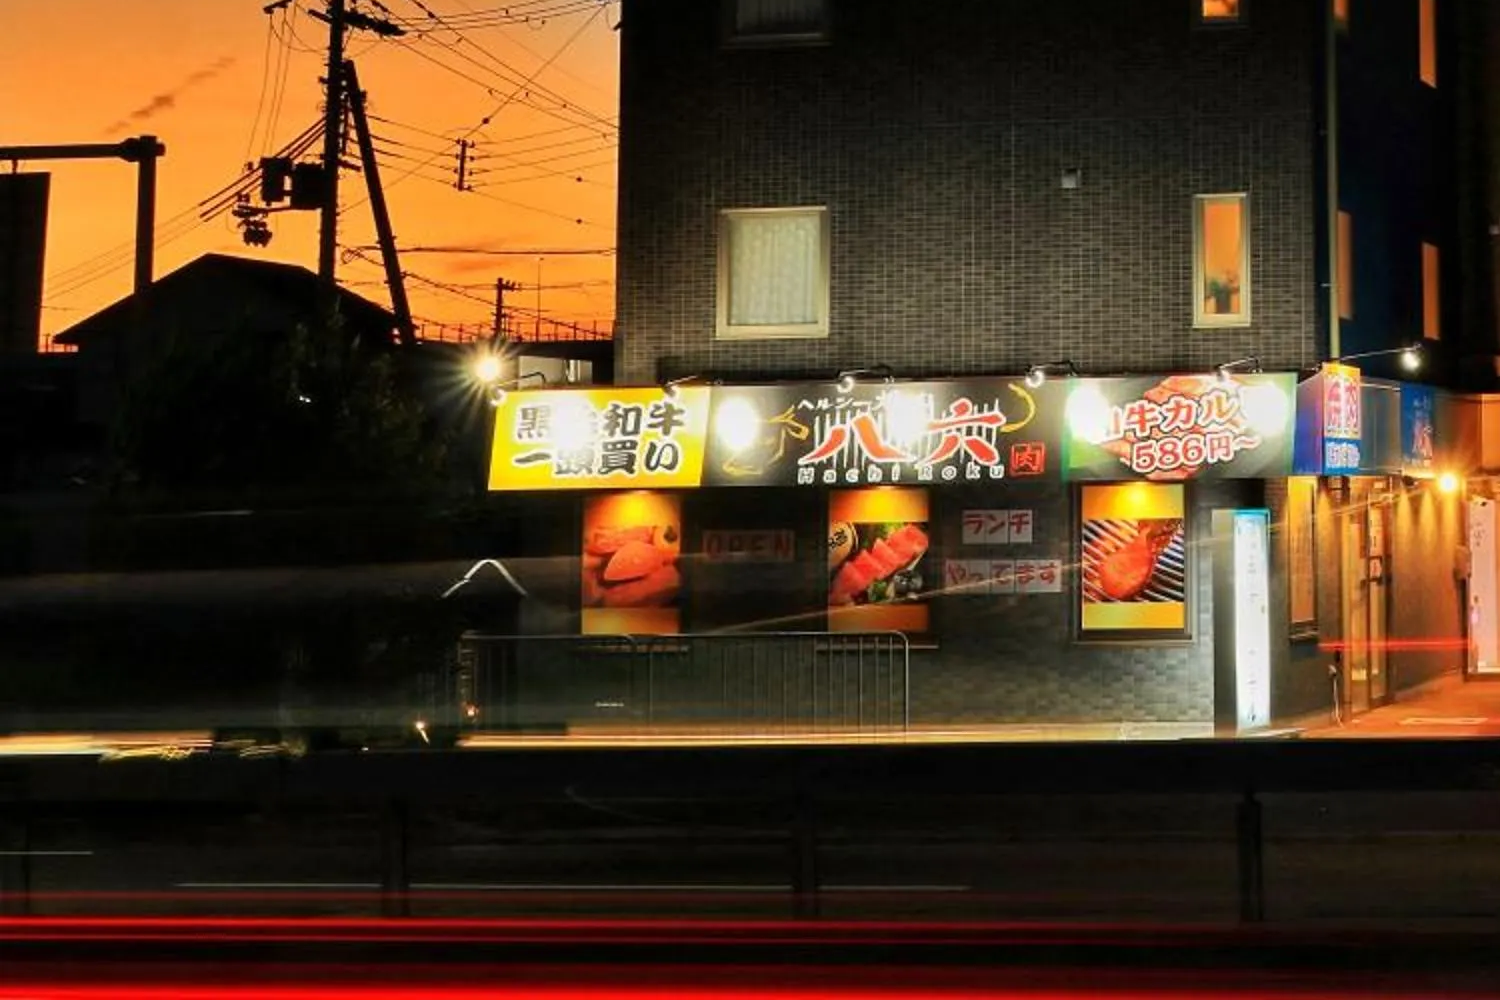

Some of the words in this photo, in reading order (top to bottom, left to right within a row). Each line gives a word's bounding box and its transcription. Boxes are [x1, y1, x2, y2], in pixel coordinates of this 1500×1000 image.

[517, 402, 685, 439] 黒和牛
[797, 397, 1006, 467] 八六
[798, 464, 900, 484] Hachi
[917, 463, 1005, 481] Roku
[963, 513, 1030, 534] ランチ
[706, 533, 790, 557] OPEN
[947, 563, 1058, 585] やってます
